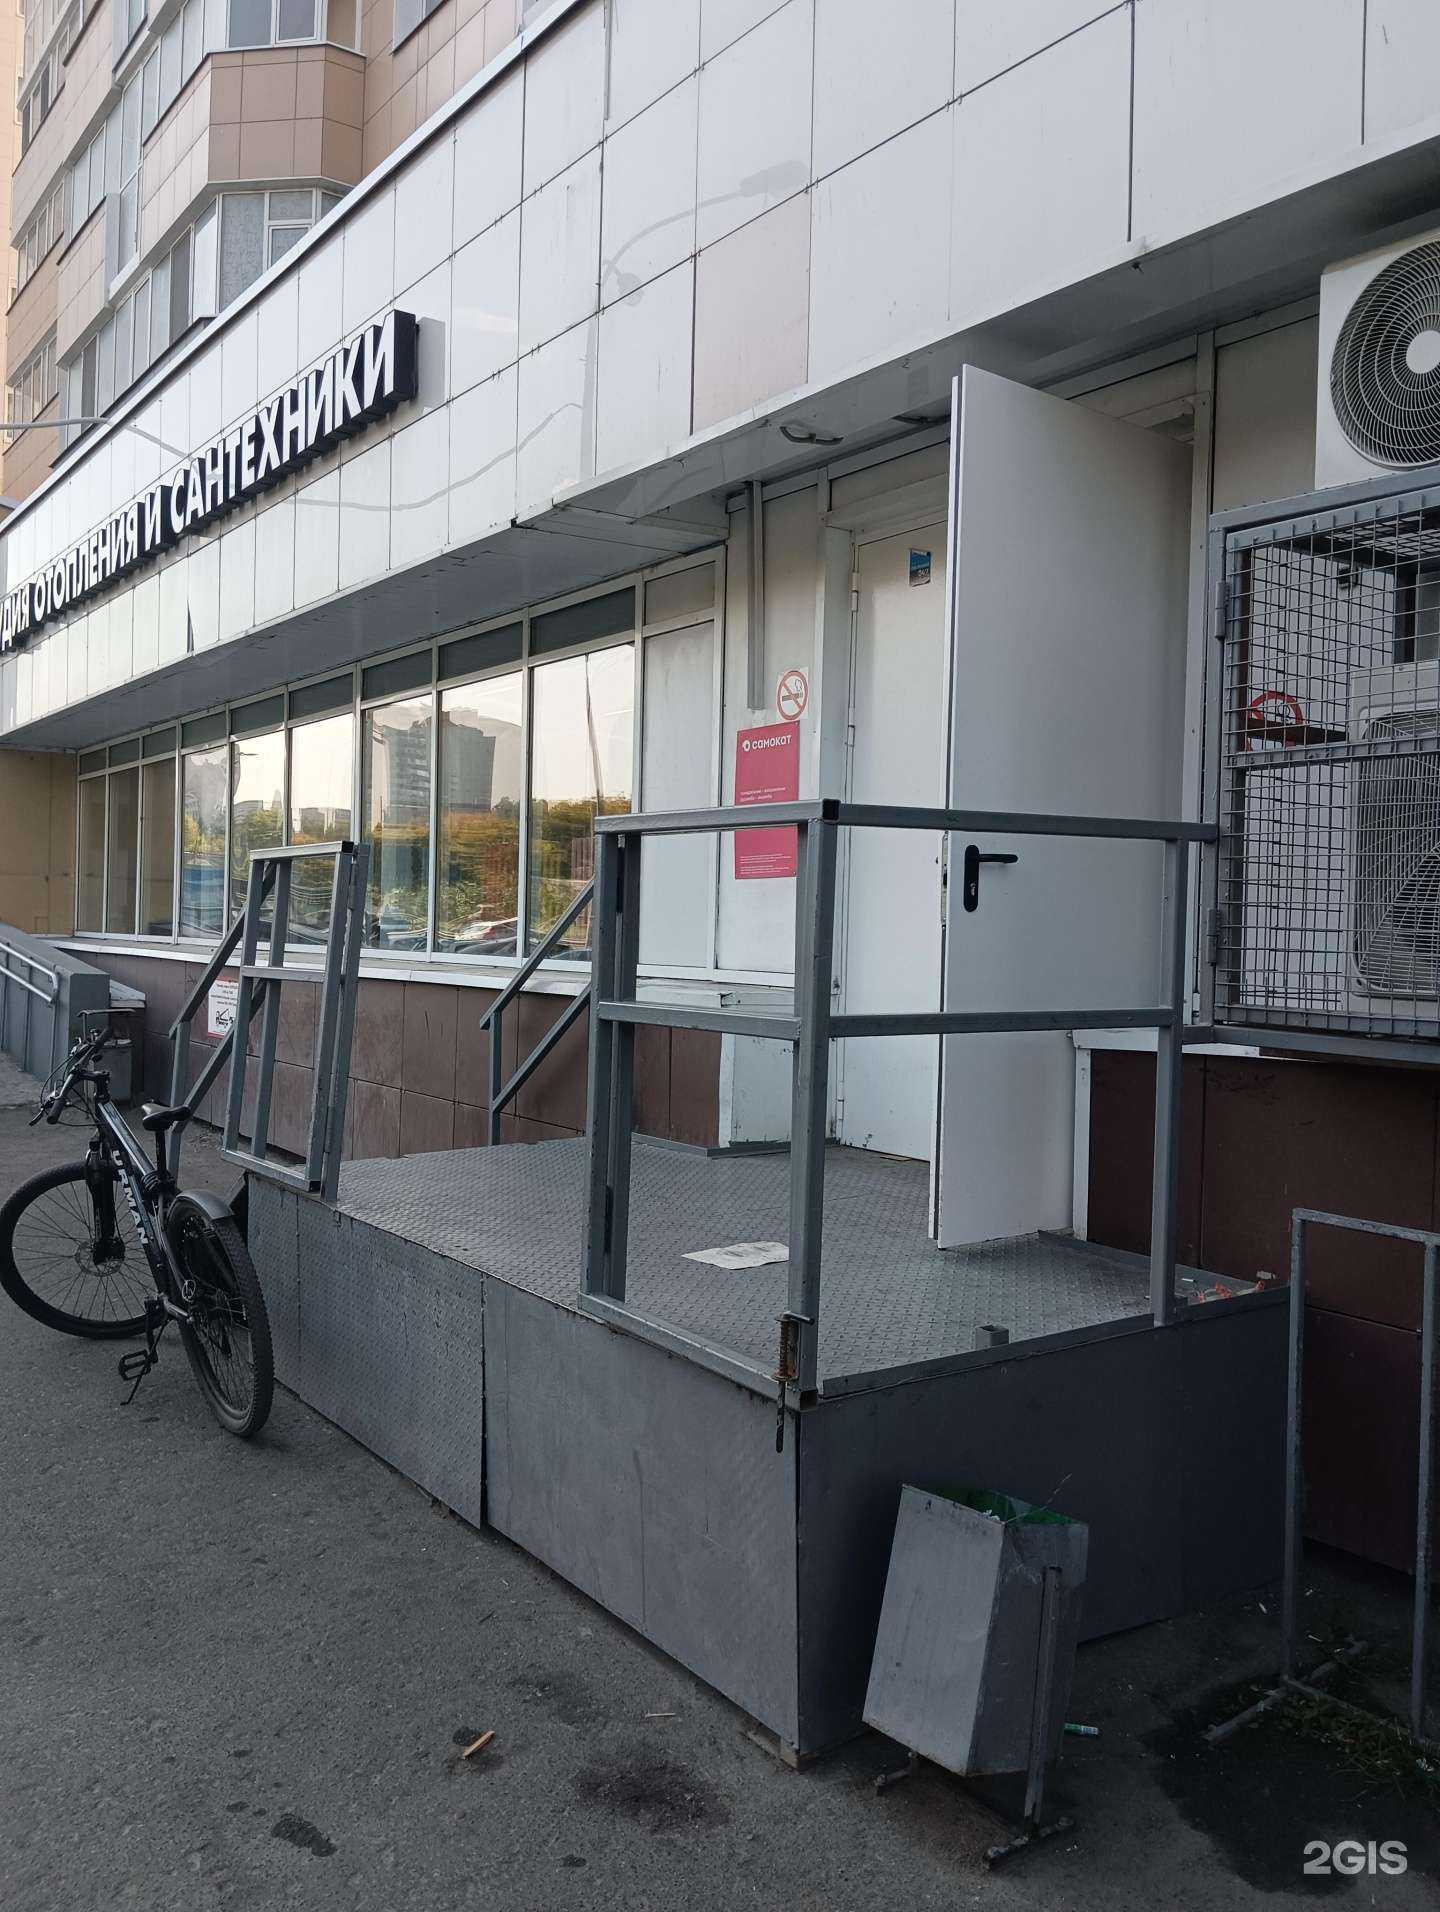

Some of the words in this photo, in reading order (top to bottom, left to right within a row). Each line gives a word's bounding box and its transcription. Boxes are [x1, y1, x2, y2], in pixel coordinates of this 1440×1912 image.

[0, 582, 30, 651] ДИЯ
[34, 501, 139, 622] ОТОПЛЕНИЯ
[145, 485, 164, 552] И
[170, 310, 398, 534] САНТЕХНИКИ
